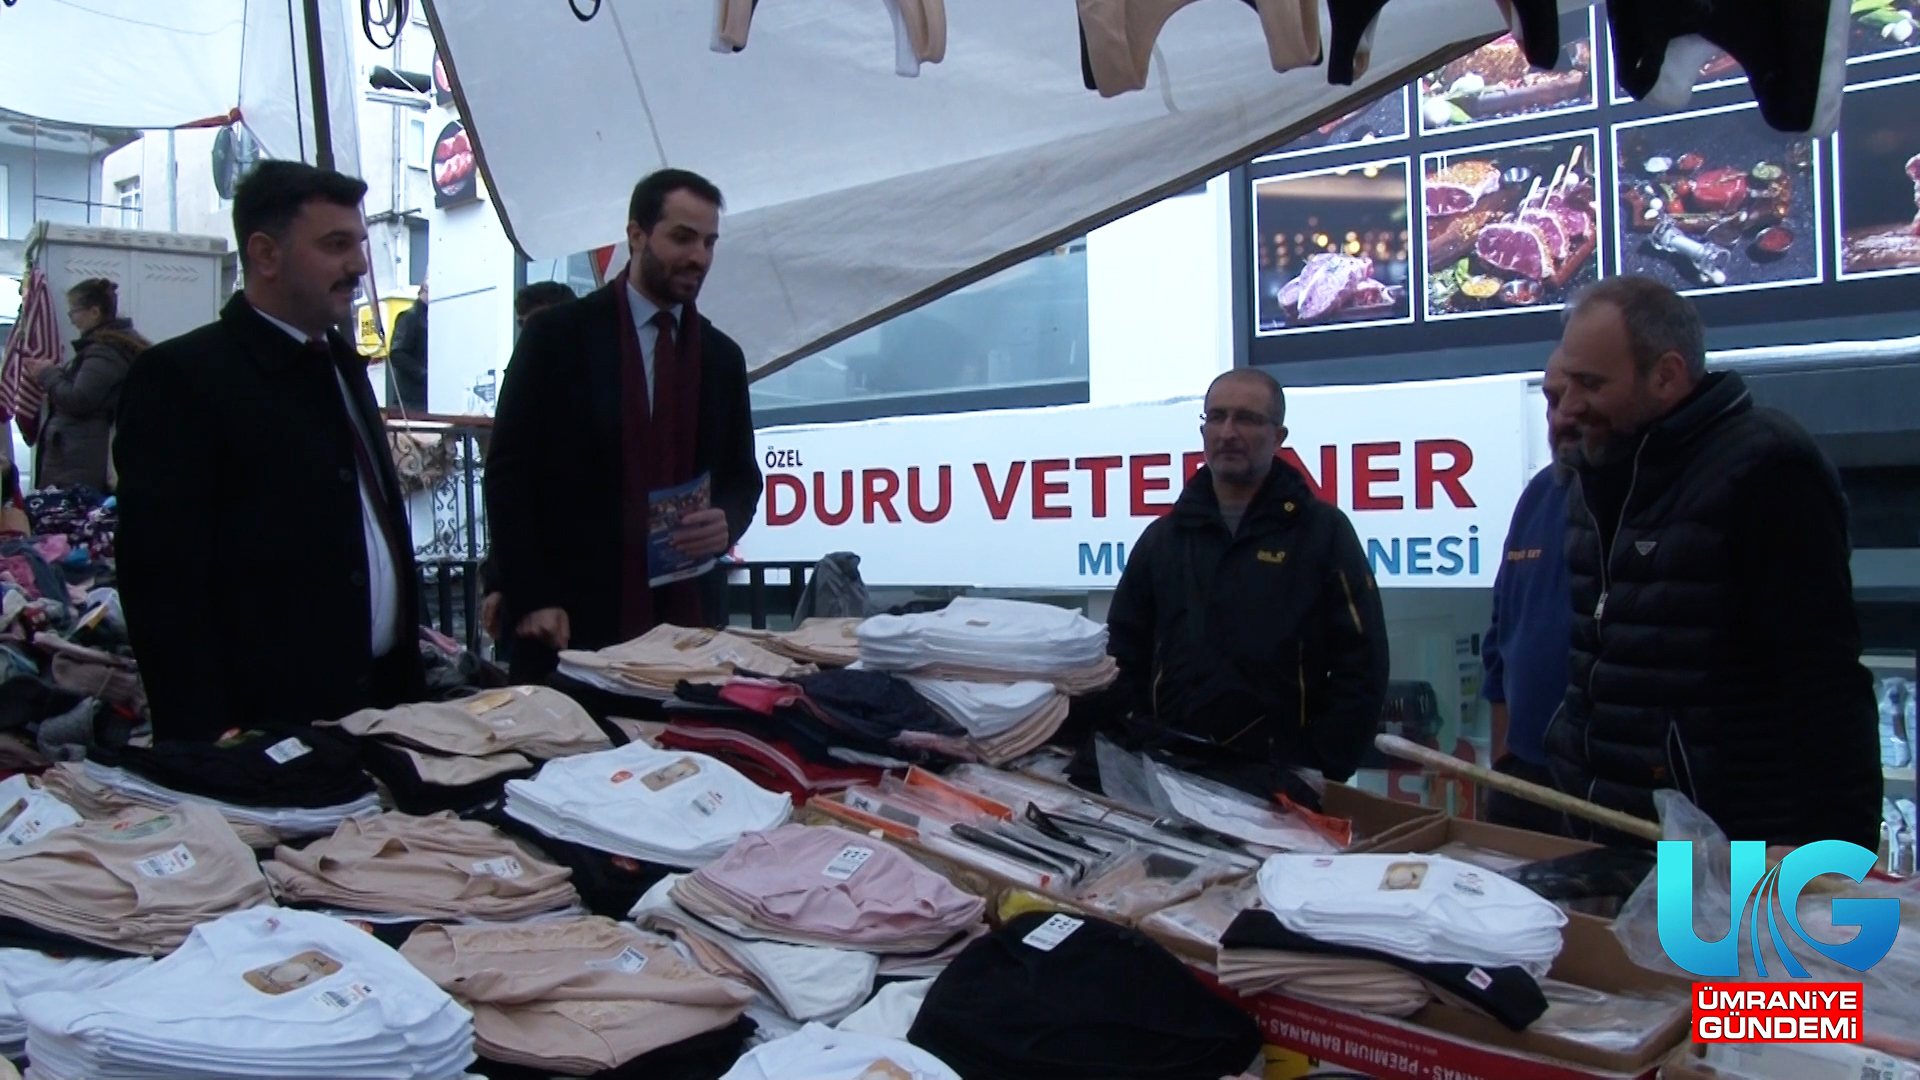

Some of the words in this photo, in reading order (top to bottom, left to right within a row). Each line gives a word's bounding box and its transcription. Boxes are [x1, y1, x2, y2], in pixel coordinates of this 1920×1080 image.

[765, 446, 804, 468] ÖZEL
[764, 464, 953, 526] DURU
[972, 438, 1478, 520] VETENER
[1269, 1018, 1341, 1053] BANANAS
[1343, 1039, 1419, 1077] PREMIUM
